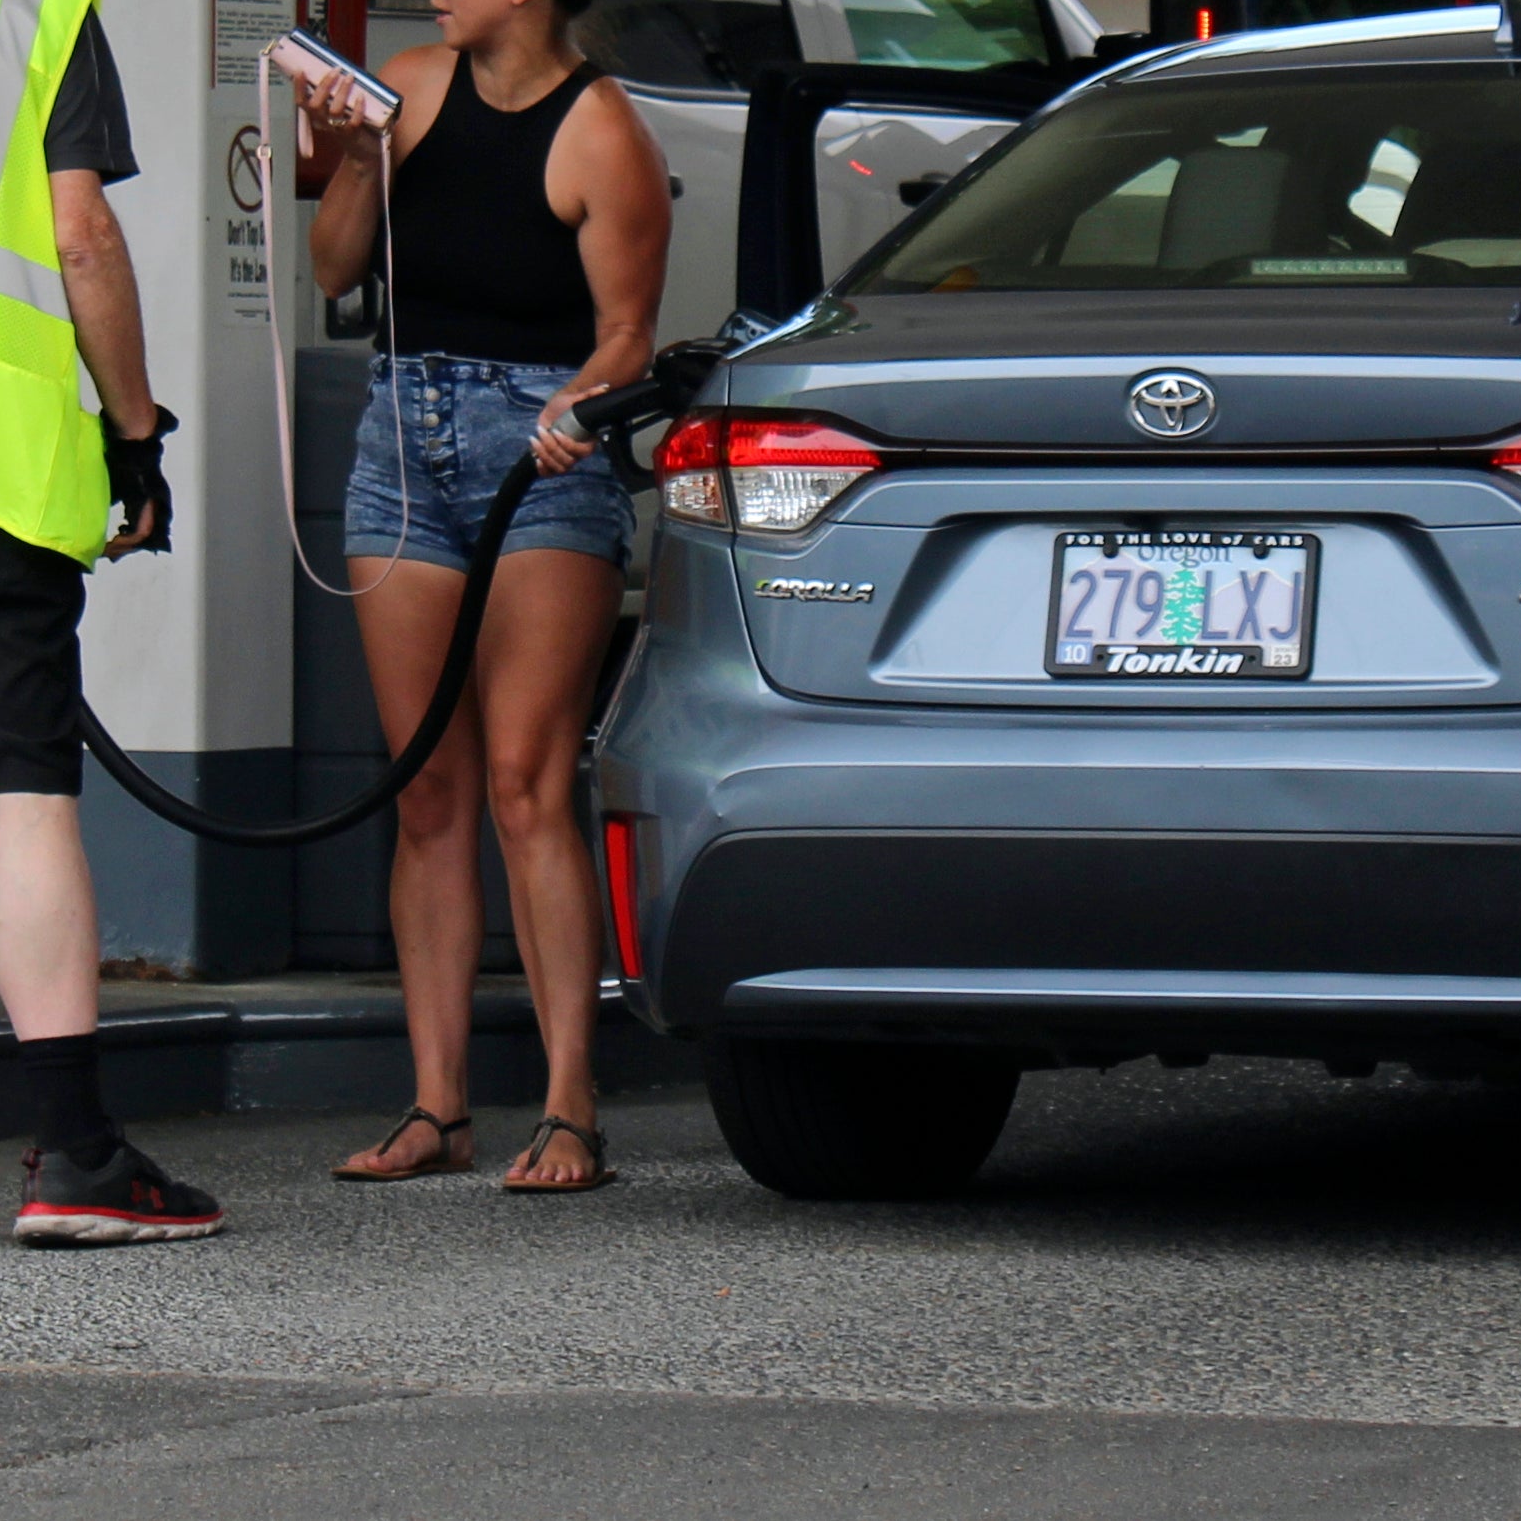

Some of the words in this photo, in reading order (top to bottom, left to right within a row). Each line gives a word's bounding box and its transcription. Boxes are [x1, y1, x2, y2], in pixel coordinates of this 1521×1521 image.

[1065, 534, 1105, 545] FOR
[1115, 533, 1151, 545] THE
[1161, 533, 1212, 544] LOVE
[1253, 535, 1304, 546] CARS
[1137, 545, 1233, 569] Oregon
[754, 577, 875, 603] COROLLA
[1064, 569, 1165, 640] 279
[1199, 570, 1303, 641] LXJ
[1062, 644, 1086, 663] 10
[1104, 645, 1245, 674] Tonkin
[1273, 654, 1293, 666] 23
